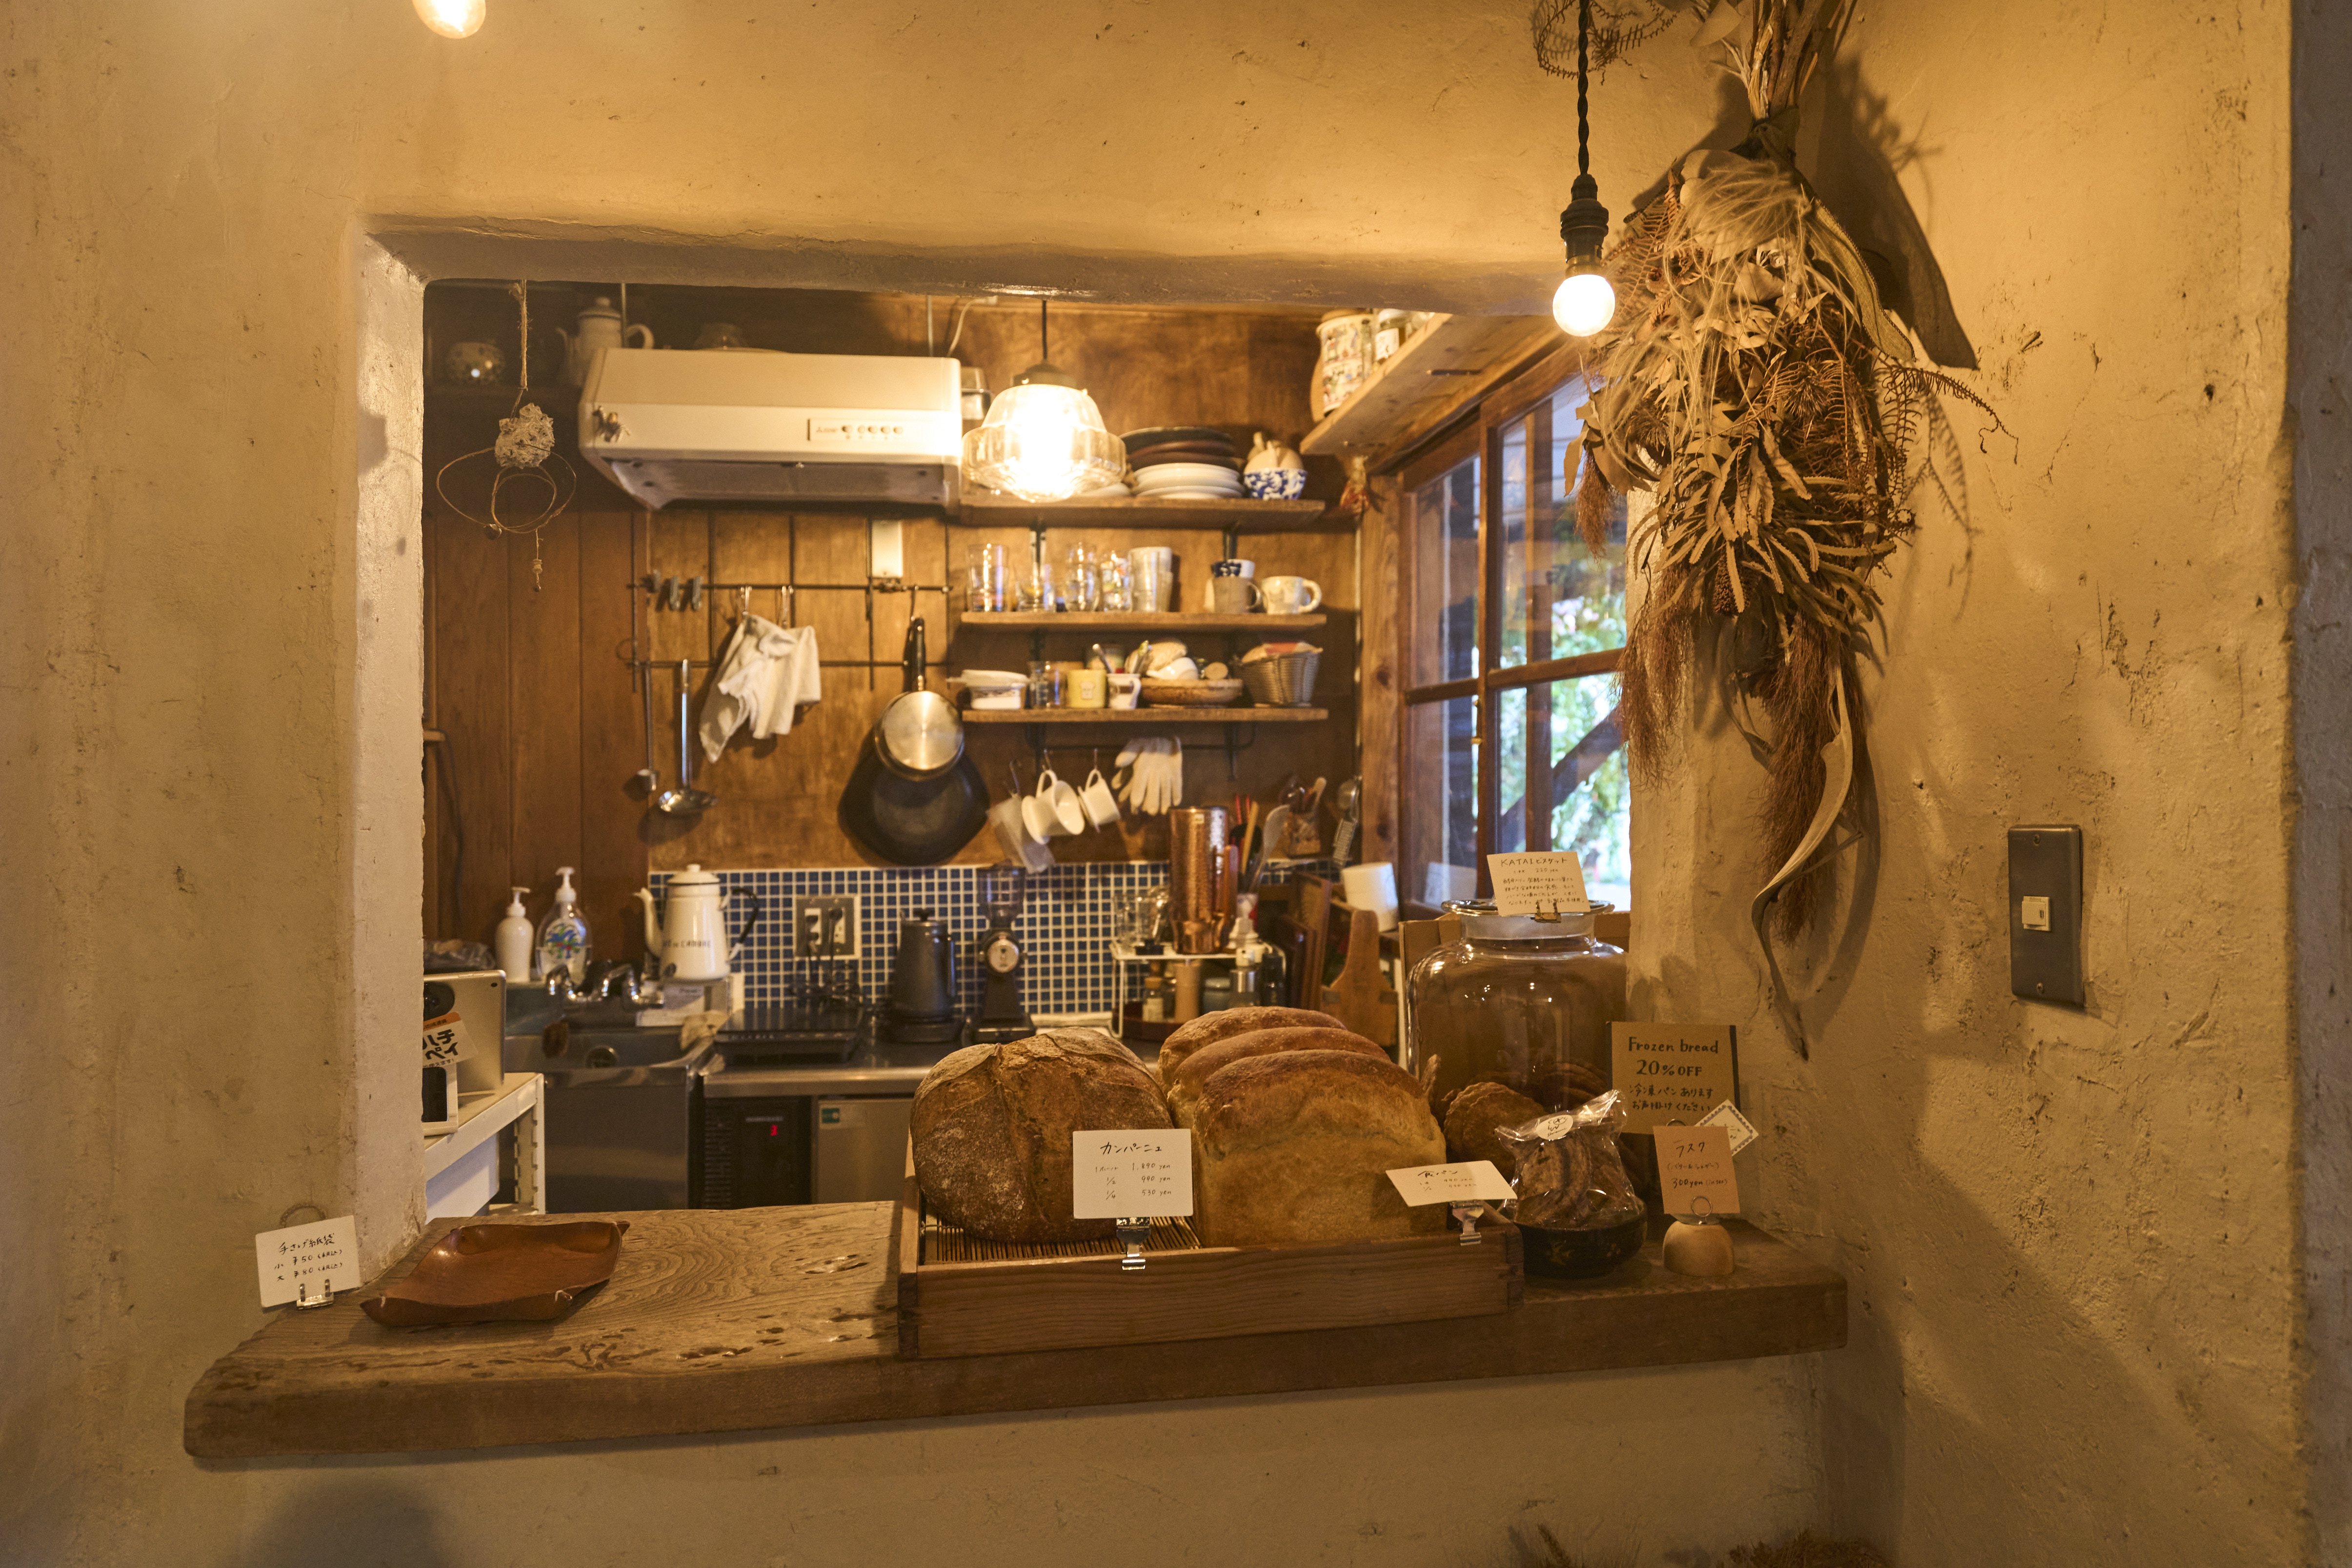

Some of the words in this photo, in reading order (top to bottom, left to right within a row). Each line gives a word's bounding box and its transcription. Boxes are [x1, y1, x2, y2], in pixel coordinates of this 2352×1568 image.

[425, 1042, 458, 1060] ペイ
[1628, 1036, 1674, 1052] Frozen
[1680, 1039, 1718, 1054] bread
[1100, 1141, 1163, 1155] カンパーニュ
[1673, 1139, 1705, 1158] ラスク
[1106, 1177, 1116, 1186] 1/2
[1106, 1190, 1116, 1200] 1/4
